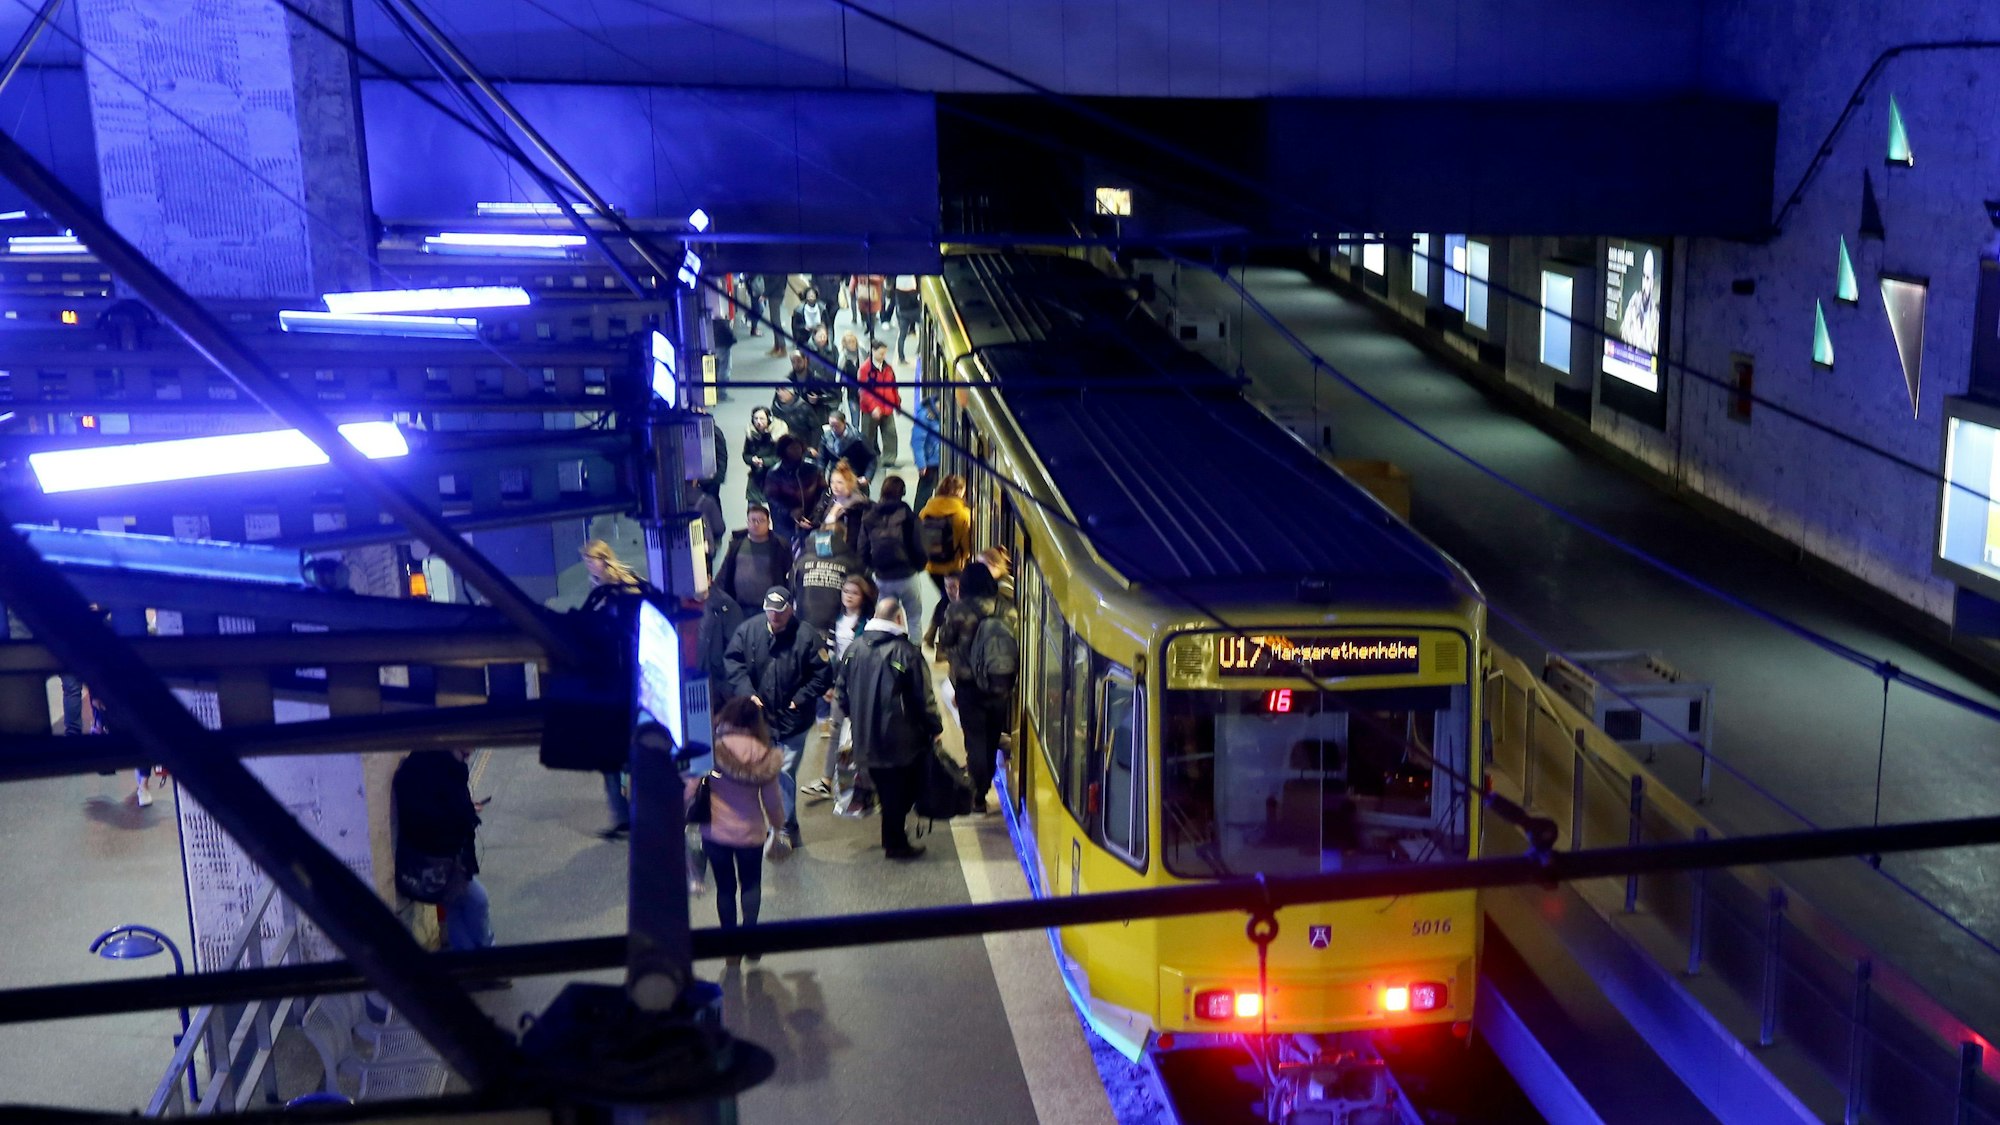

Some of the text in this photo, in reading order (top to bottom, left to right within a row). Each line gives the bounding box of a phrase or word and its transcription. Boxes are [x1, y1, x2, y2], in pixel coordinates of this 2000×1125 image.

[1219, 636, 1418, 668] U17 Margarethenhöhe
[1269, 689, 1292, 712] 16
[1411, 918, 1452, 936] 5016
